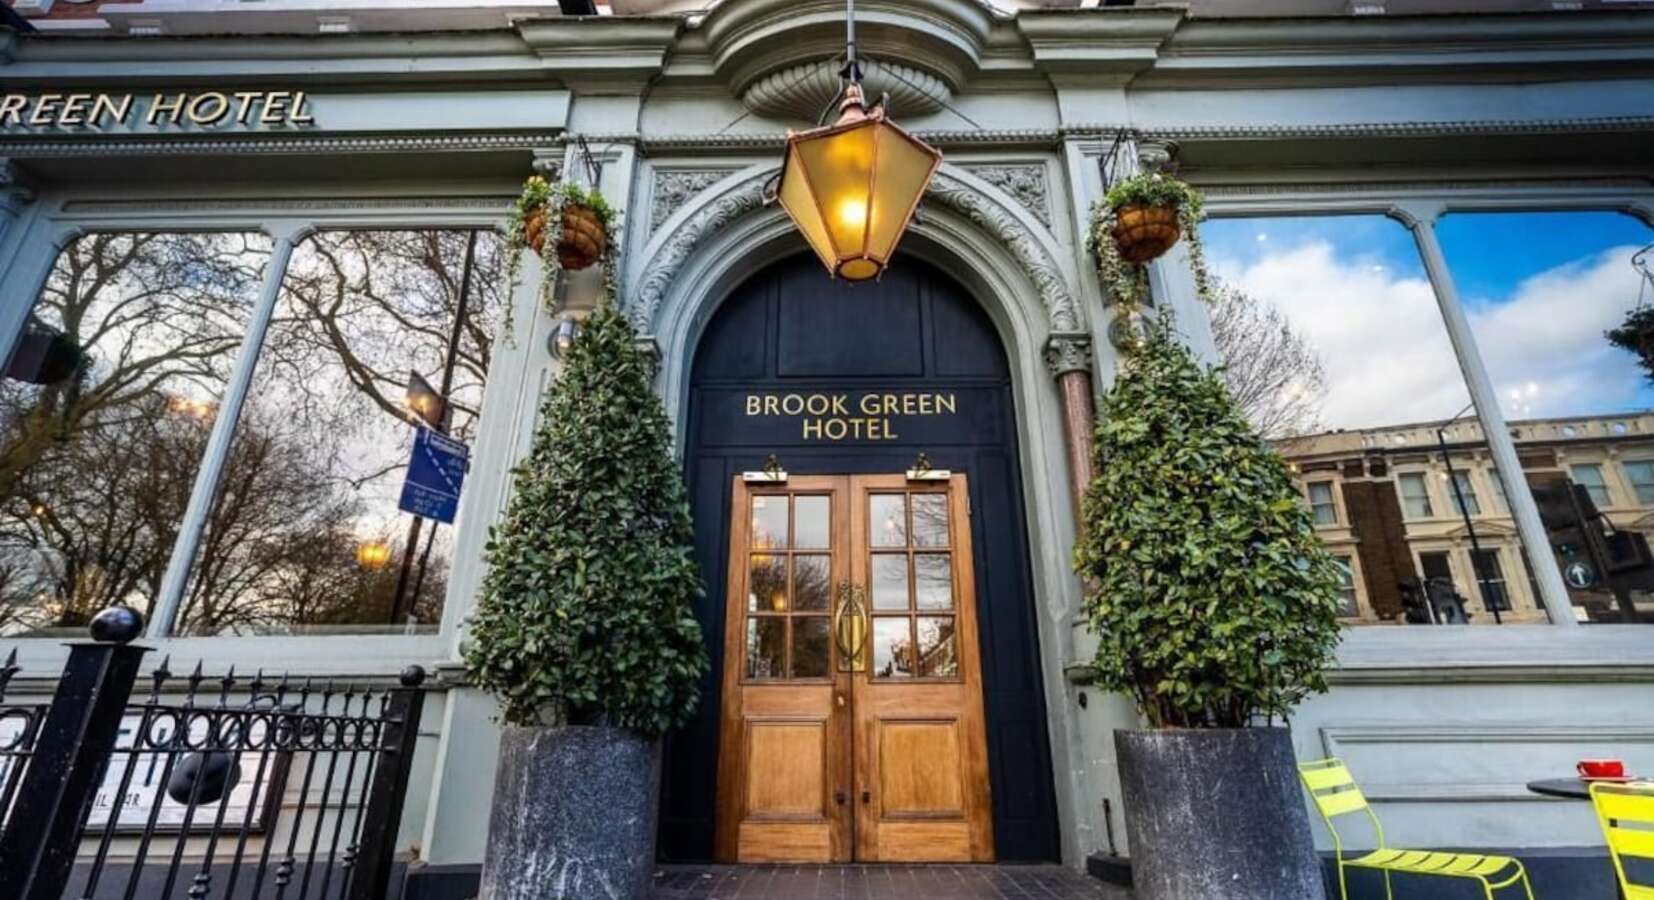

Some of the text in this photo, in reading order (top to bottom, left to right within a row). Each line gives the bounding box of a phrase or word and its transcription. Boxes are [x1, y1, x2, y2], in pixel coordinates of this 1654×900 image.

[146, 91, 314, 124] HOTEL
[746, 394, 956, 415] BROOK GREEN
[803, 418, 898, 440] HOTEL
